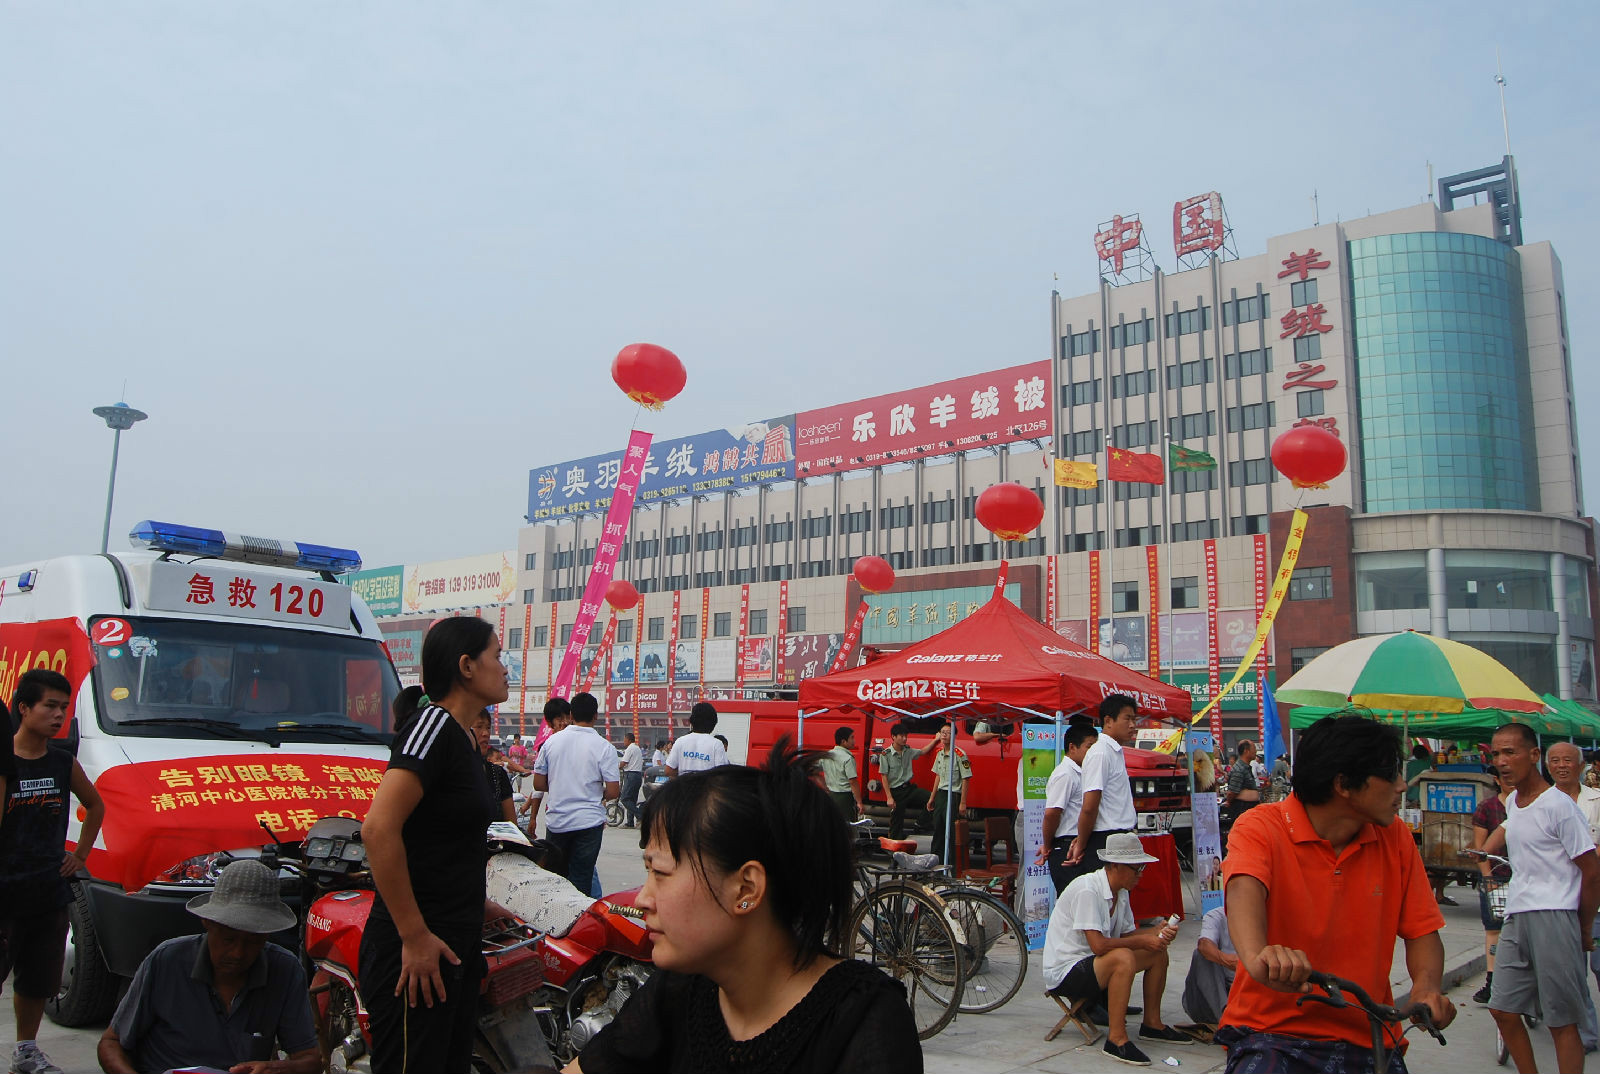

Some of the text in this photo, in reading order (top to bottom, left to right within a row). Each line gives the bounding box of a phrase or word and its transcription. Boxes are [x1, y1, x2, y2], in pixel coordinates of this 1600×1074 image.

[1094, 191, 1224, 276] 中国
[619, 446, 644, 497] 聚人气
[594, 521, 623, 576] 抓商机
[186, 573, 324, 618] 急救 120
[418, 577, 446, 597] 广告招商
[100, 619, 124, 644] 2
[906, 653, 964, 664] Galanz
[856, 677, 981, 701] Galanz 格兰仕
[683, 751, 711, 762] KOREA
[159, 764, 384, 788] 告别眼镜 清晰
